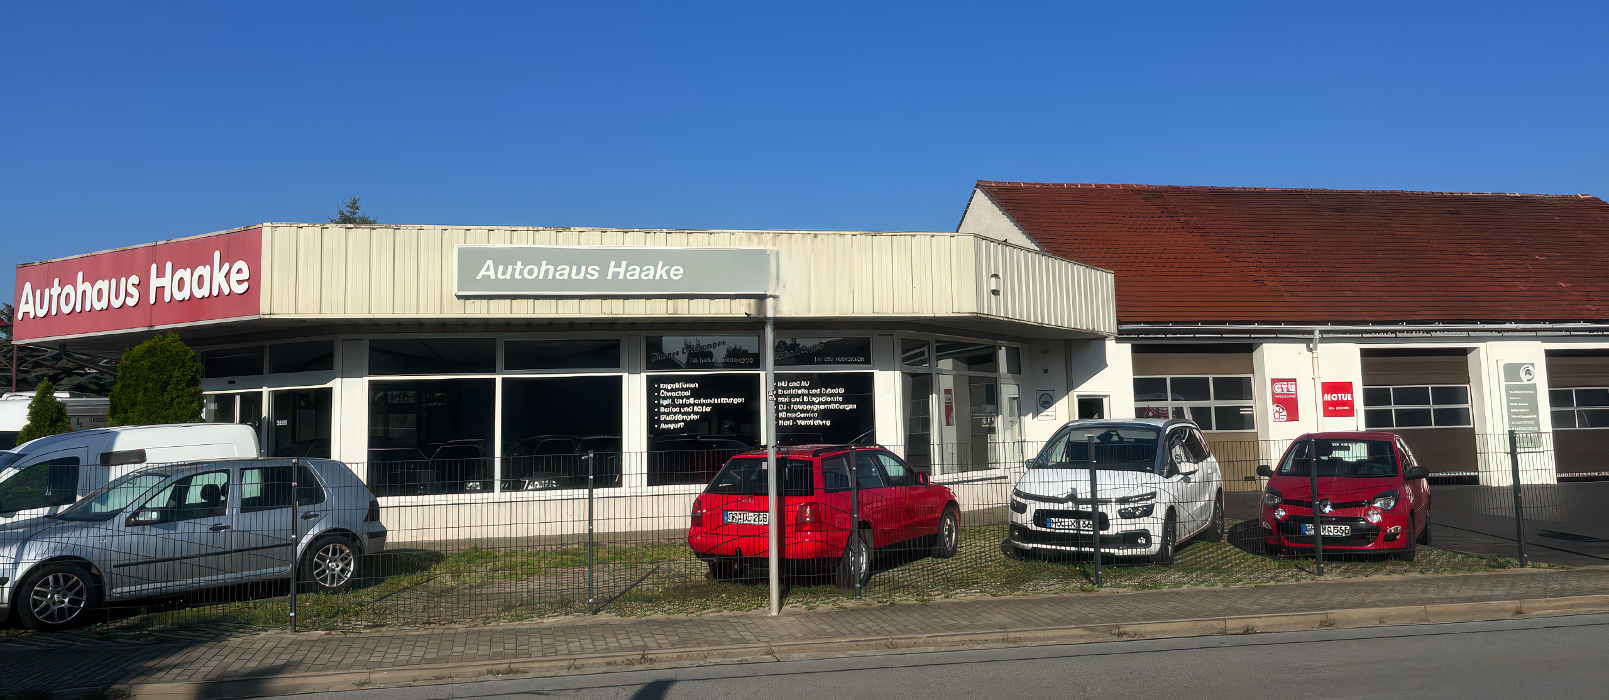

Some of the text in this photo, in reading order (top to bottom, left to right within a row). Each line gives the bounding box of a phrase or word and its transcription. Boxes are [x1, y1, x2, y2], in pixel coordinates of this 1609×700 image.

[475, 259, 684, 281] Autohaus Haake
[17, 250, 250, 320] Autohaus Haake
[1323, 393, 1353, 401] MOTUL
